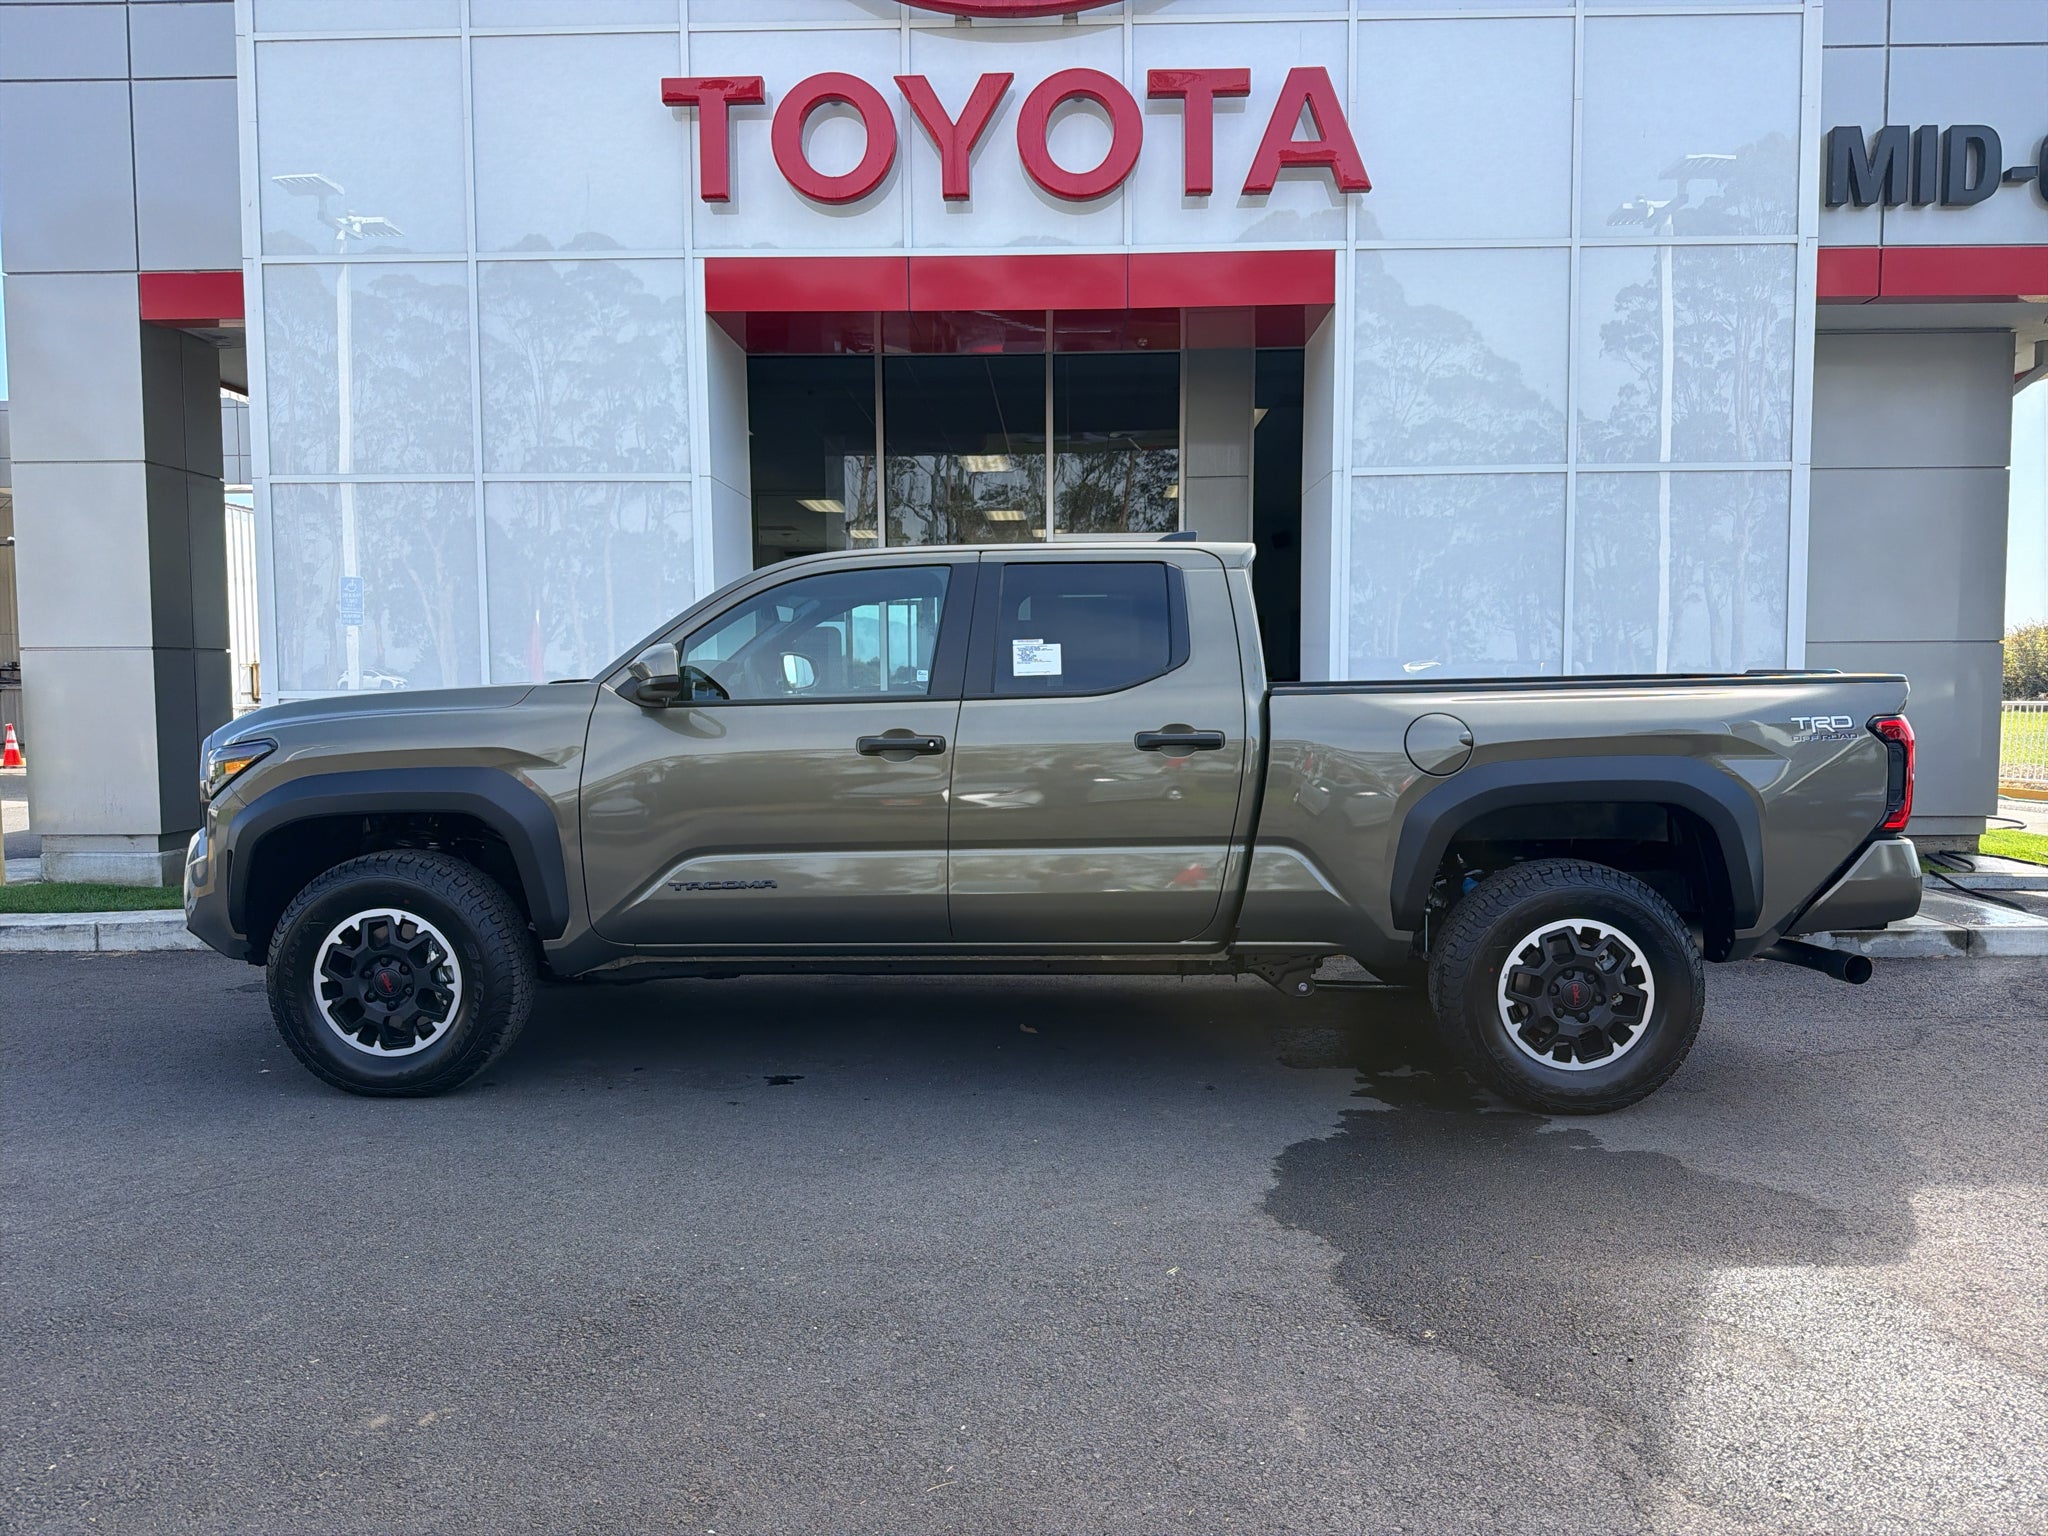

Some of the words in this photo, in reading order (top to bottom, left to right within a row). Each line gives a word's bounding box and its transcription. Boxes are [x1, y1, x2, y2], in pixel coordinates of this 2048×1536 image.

[660, 66, 1373, 205] TOYOTA
[1825, 124, 2048, 208] MID-
[1790, 715, 1855, 733] TRD
[667, 879, 778, 892] TACOMA
